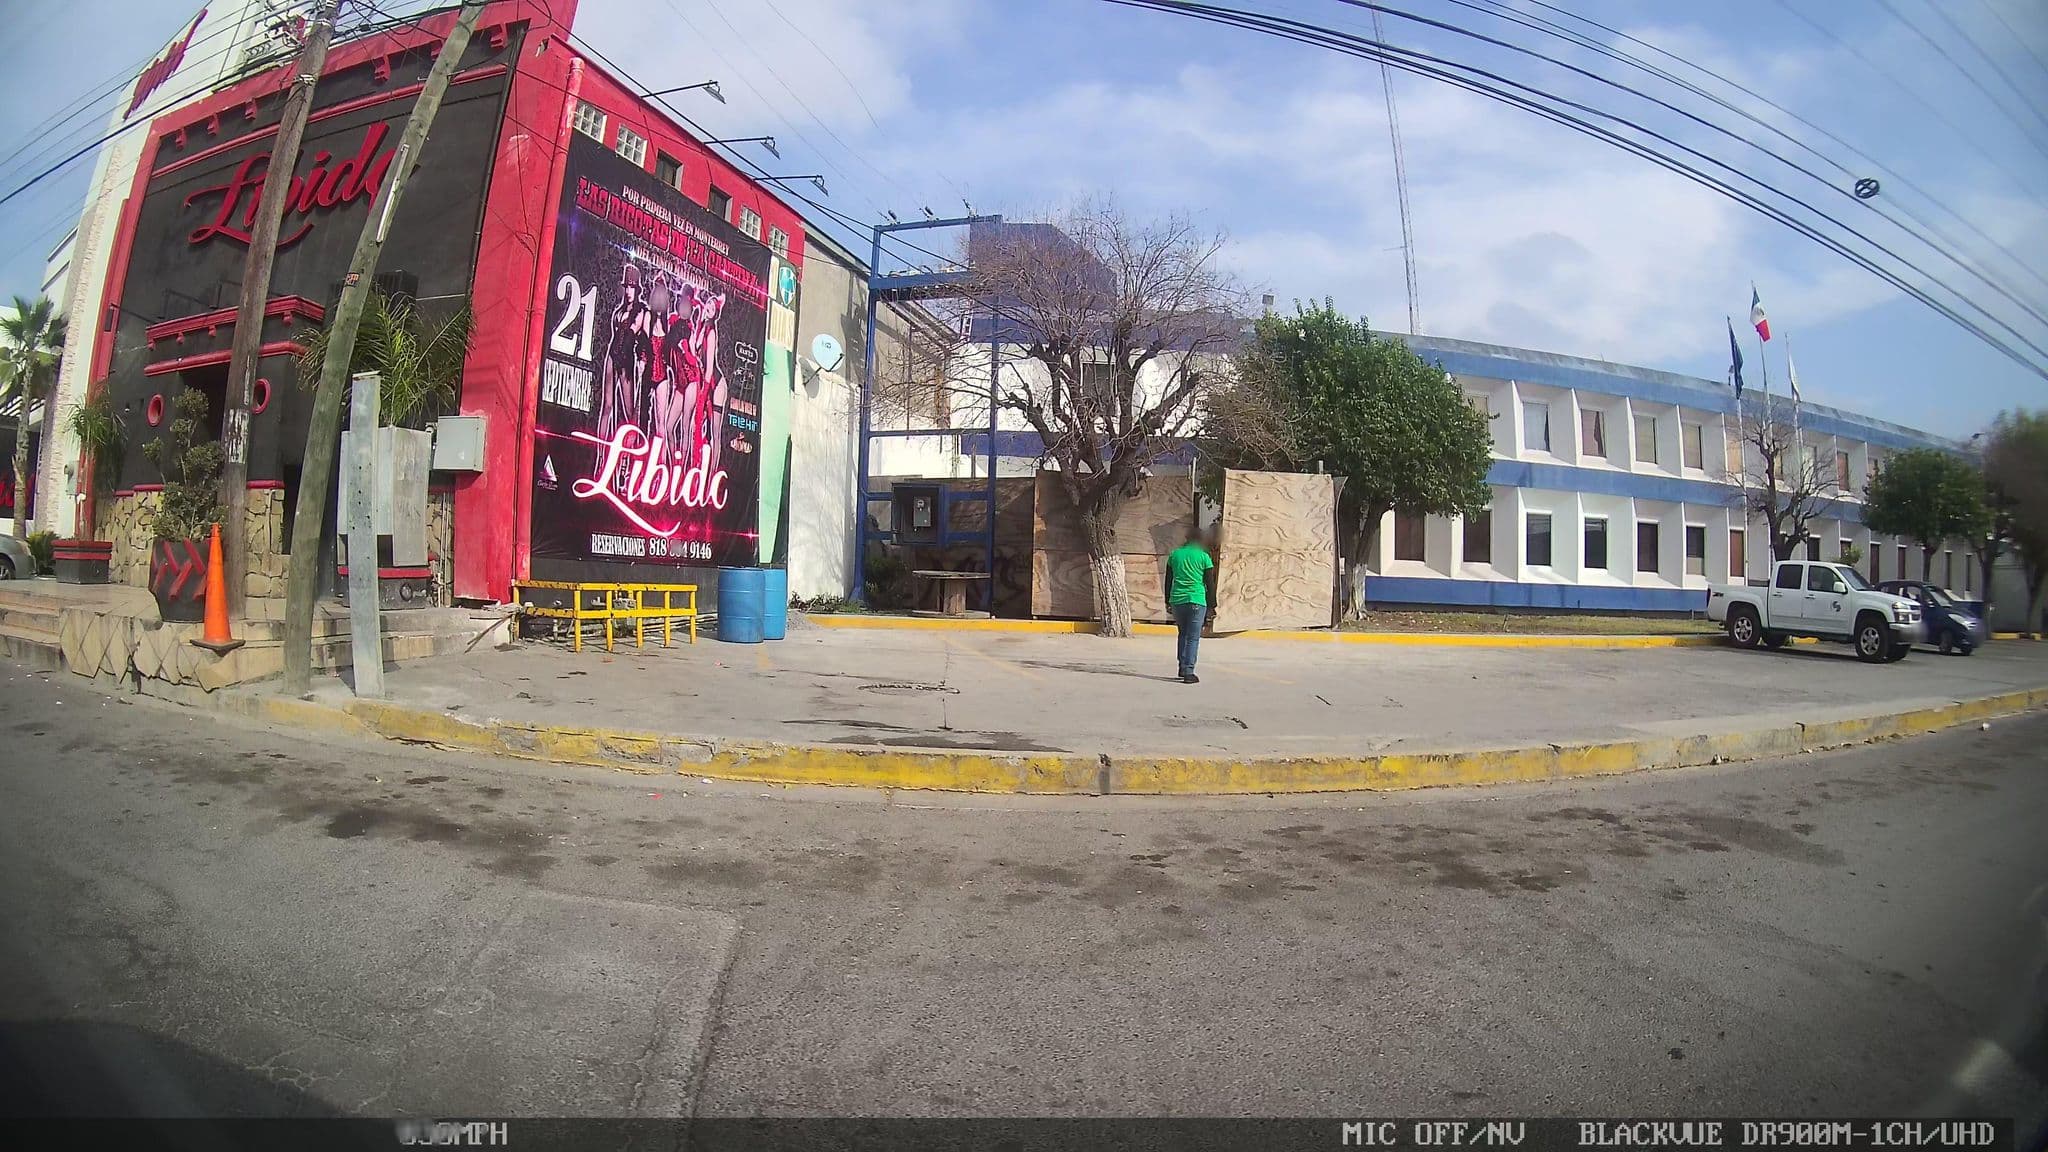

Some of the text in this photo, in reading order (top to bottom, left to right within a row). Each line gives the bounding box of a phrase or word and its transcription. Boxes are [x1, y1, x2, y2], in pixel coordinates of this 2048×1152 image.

[576, 176, 610, 220] LAS
[622, 185, 730, 256] POR PRIMERA VEZ EN MONTERREY
[550, 272, 597, 362] 21
[542, 358, 593, 413] SEPTIEMBRE
[591, 533, 645, 556] RESERVACIONES
[649, 537, 668, 556] 818
[690, 540, 712, 559] 9146
